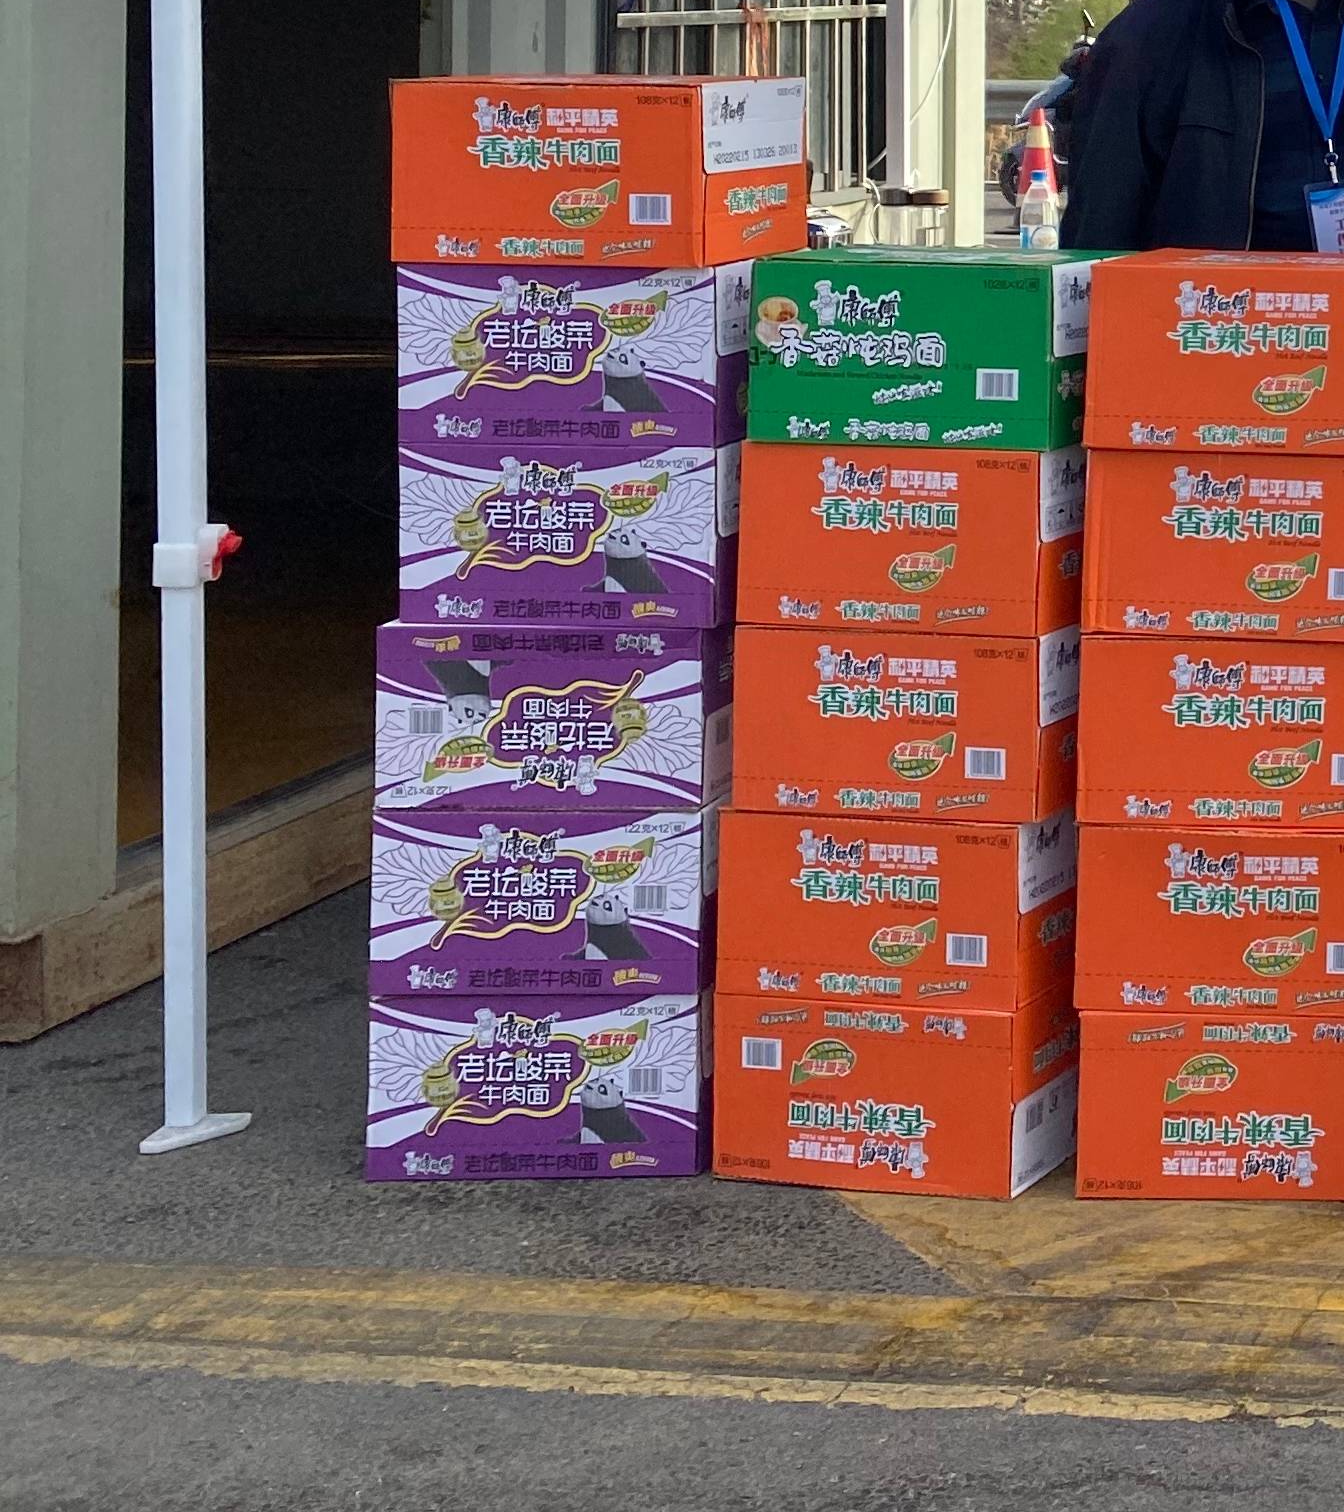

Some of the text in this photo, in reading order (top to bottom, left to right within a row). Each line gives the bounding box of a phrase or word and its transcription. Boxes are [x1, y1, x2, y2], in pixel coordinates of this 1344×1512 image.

[467, 136, 621, 171] 香辣牛肉面
[483, 319, 595, 351] 老坛酸菜
[769, 325, 947, 368] 香菇炖鸡面
[1167, 322, 1330, 356] 香辣牛肉面
[504, 351, 574, 374] 牛肉面
[485, 500, 595, 531] 老坛酸菜
[811, 498, 958, 534] 香辣牛肉面
[1161, 506, 1323, 542] 香辣牛肉面
[506, 531, 575, 553] 牛肉面
[522, 698, 593, 719] 牛肉面
[808, 684, 958, 721] 香辣牛肉面
[1162, 693, 1325, 730] 香辣牛肉面
[463, 867, 577, 899] 老坛酸菜
[790, 869, 940, 905] 香辣牛肉面
[484, 899, 555, 921] 牛肉面
[1158, 882, 1320, 918] 香辣牛肉面
[457, 1052, 572, 1083] 老坛酸菜
[478, 1084, 550, 1106] 牛肉面
